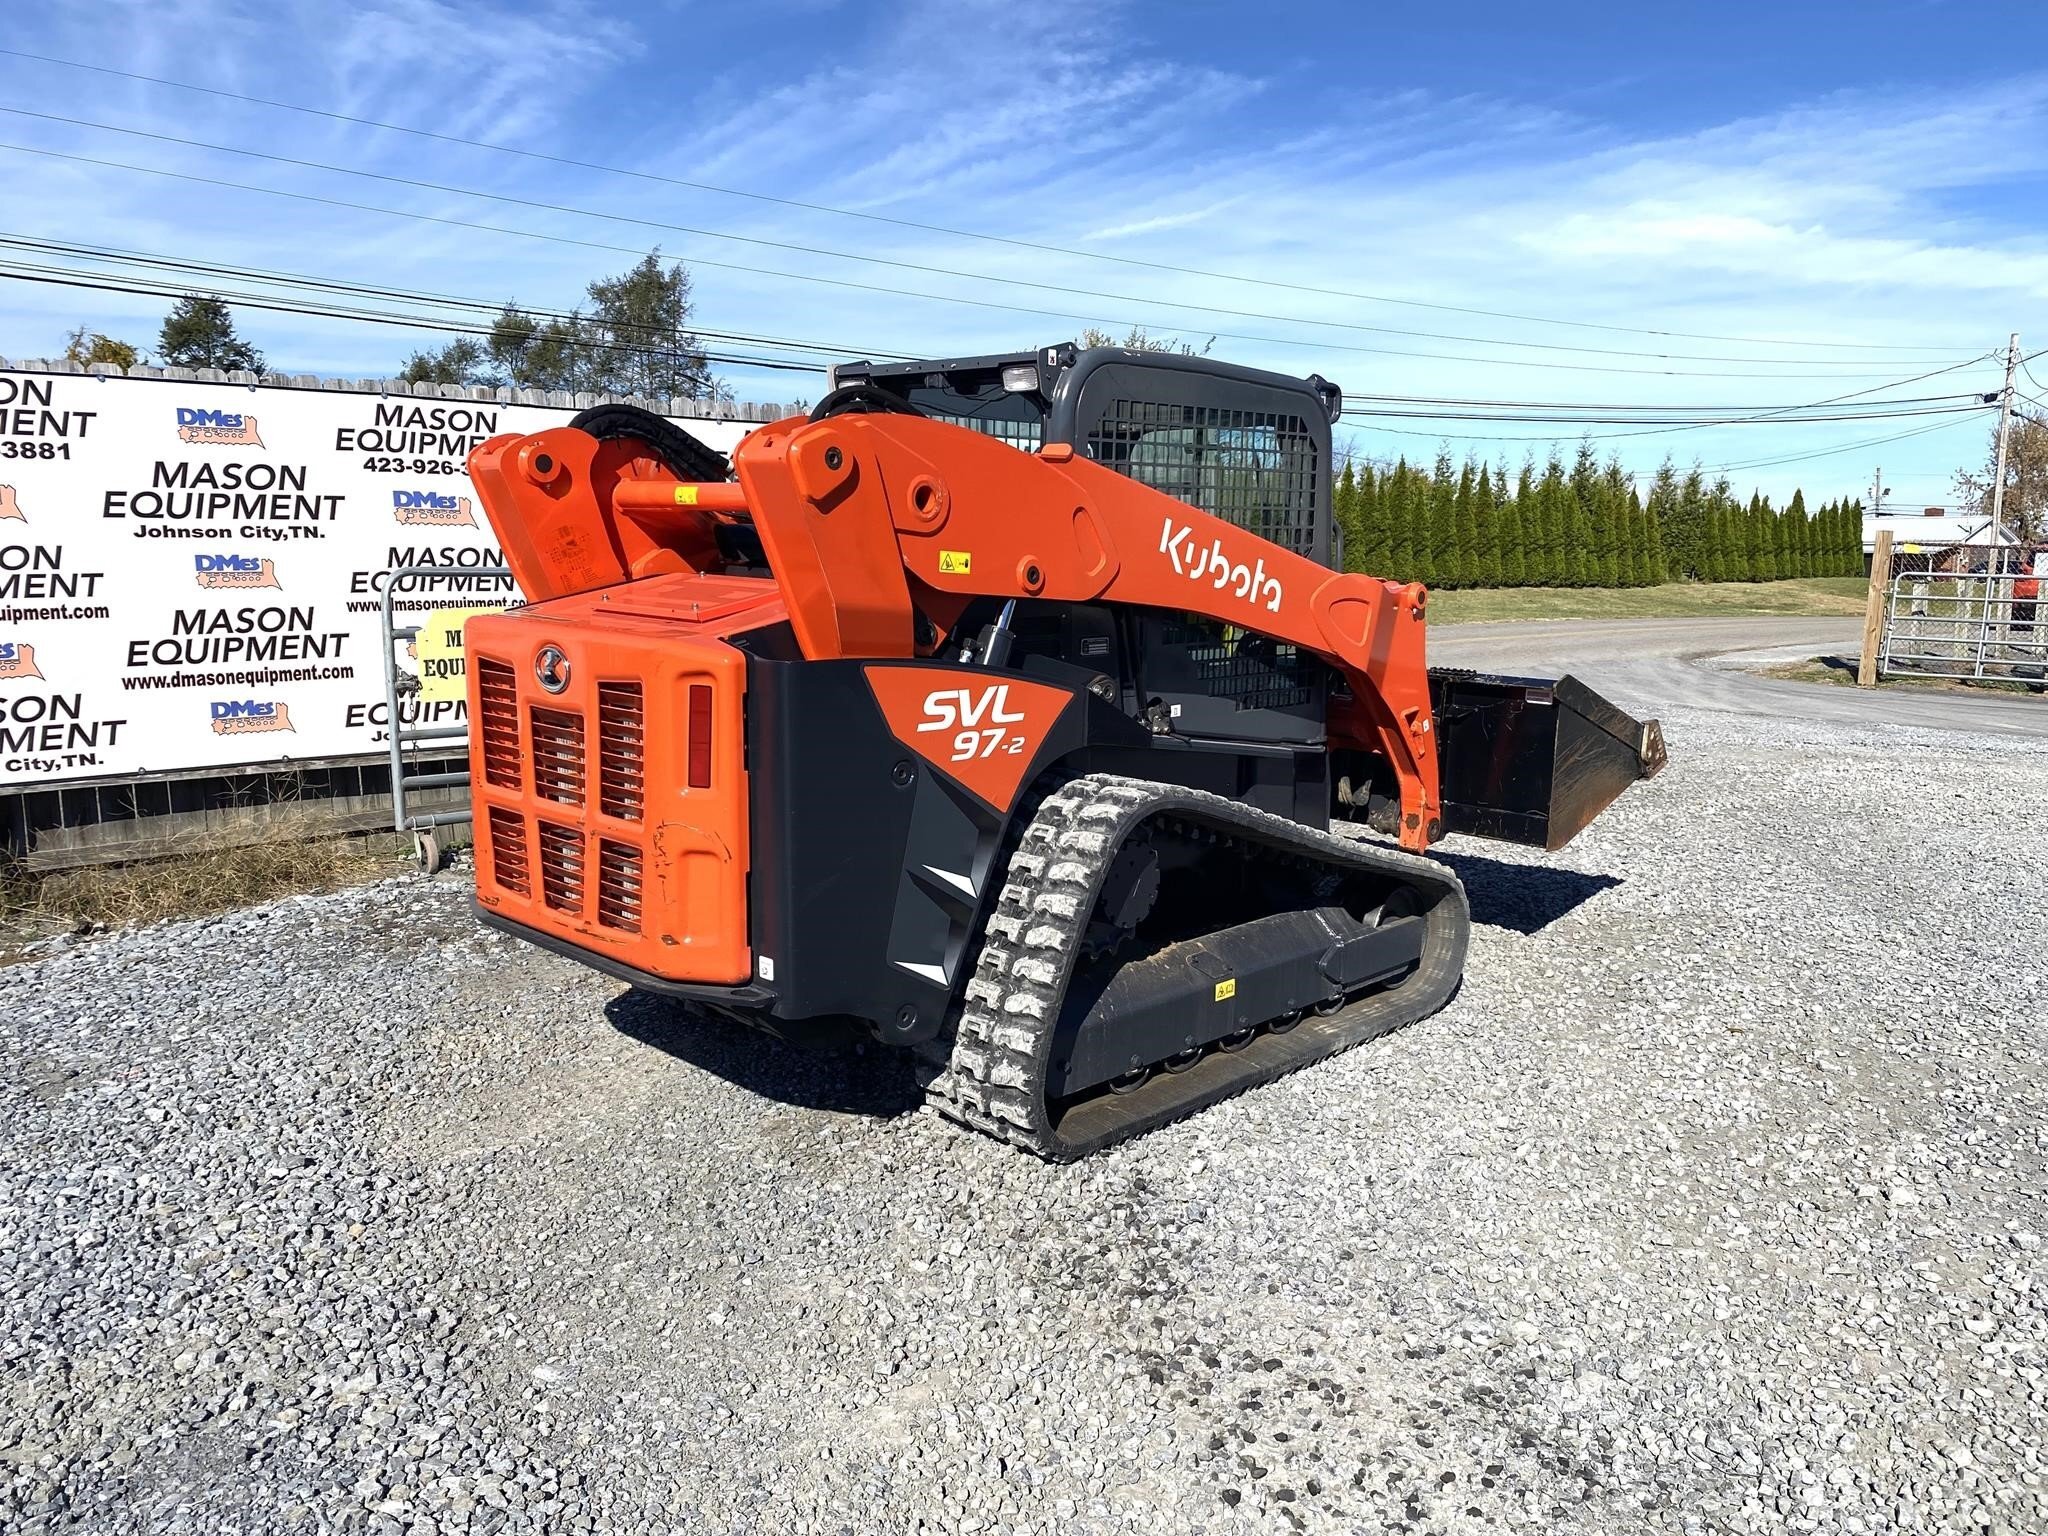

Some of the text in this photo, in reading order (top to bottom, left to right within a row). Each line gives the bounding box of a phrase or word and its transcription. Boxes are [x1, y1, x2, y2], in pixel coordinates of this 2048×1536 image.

[0, 408, 97, 438] ENT
[375, 403, 497, 433] MASON
[336, 427, 492, 457] EQUIPME
[152, 461, 306, 490] MASON
[103, 490, 345, 520] EQUIPMENT
[134, 525, 232, 539] Johnson
[387, 547, 504, 568] MASON
[1160, 517, 1282, 613] Kubota
[173, 606, 315, 636] MASON
[127, 633, 350, 667] EQUIPMENT
[122, 664, 354, 690] www.dmasonequipment.com
[0, 694, 82, 724] ON
[917, 685, 1024, 732] SVL
[951, 728, 1025, 761] 97-2
